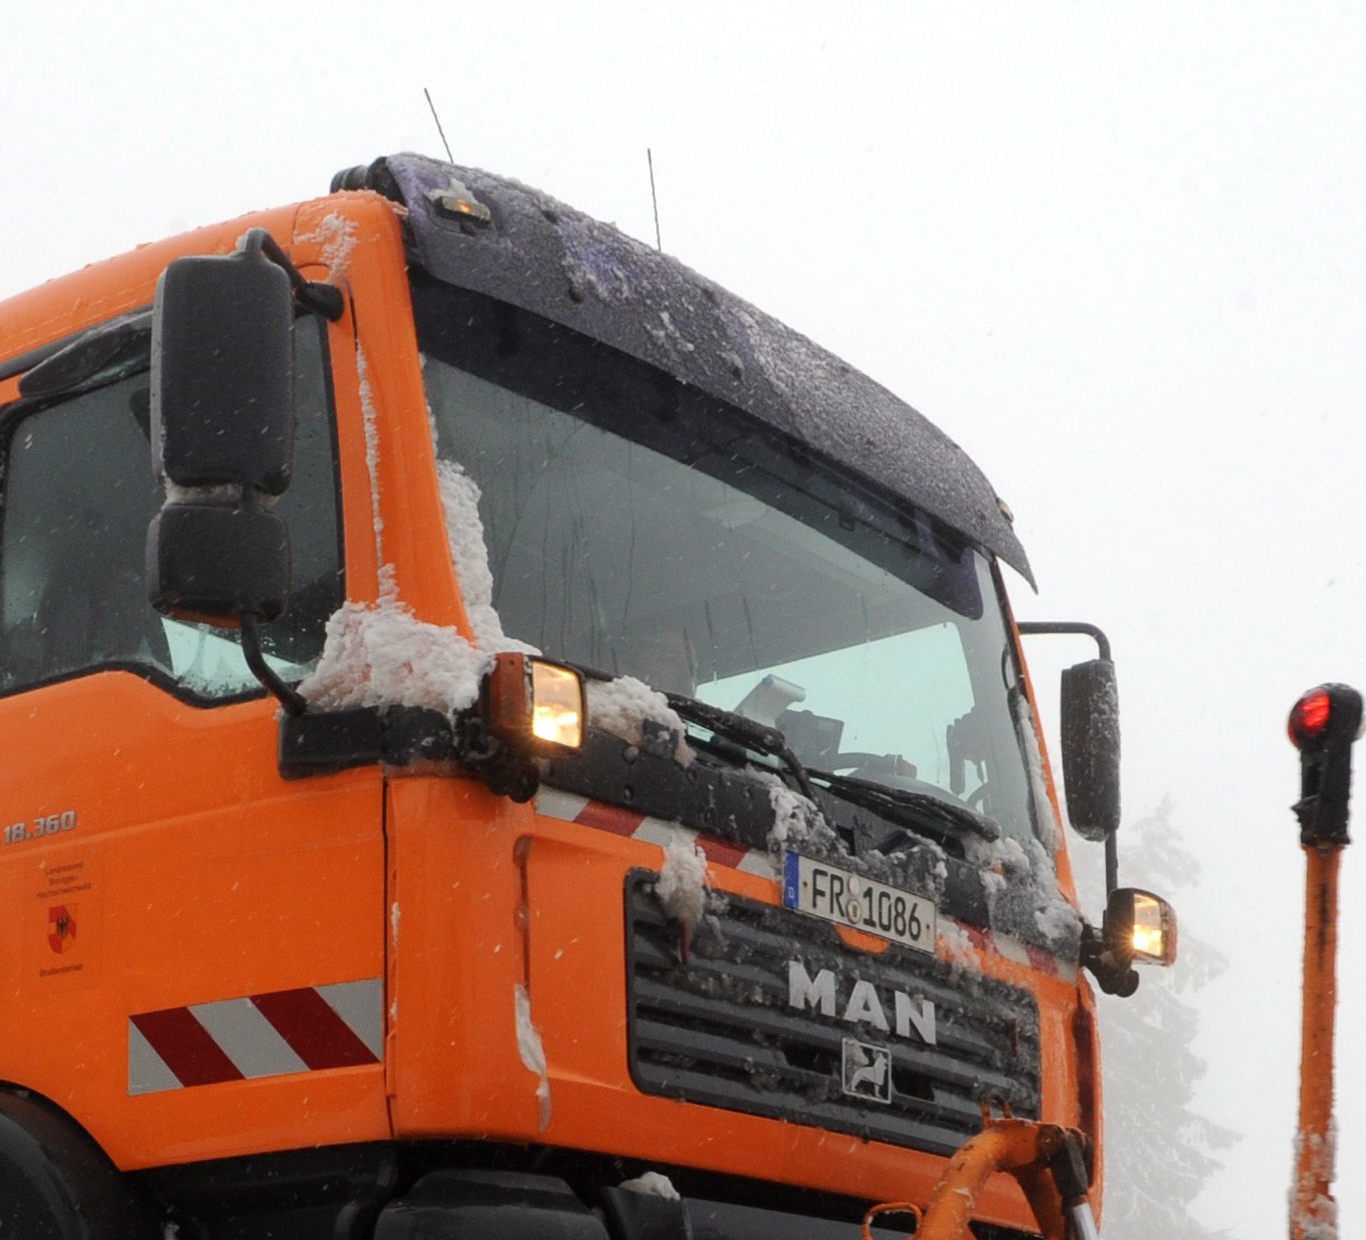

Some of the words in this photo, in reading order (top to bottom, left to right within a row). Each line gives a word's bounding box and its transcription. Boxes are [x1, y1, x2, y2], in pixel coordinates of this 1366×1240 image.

[4, 810, 76, 844] 18.360
[811, 868, 845, 918] FR
[863, 886, 922, 941] 1086
[788, 959, 937, 1046] MAN
